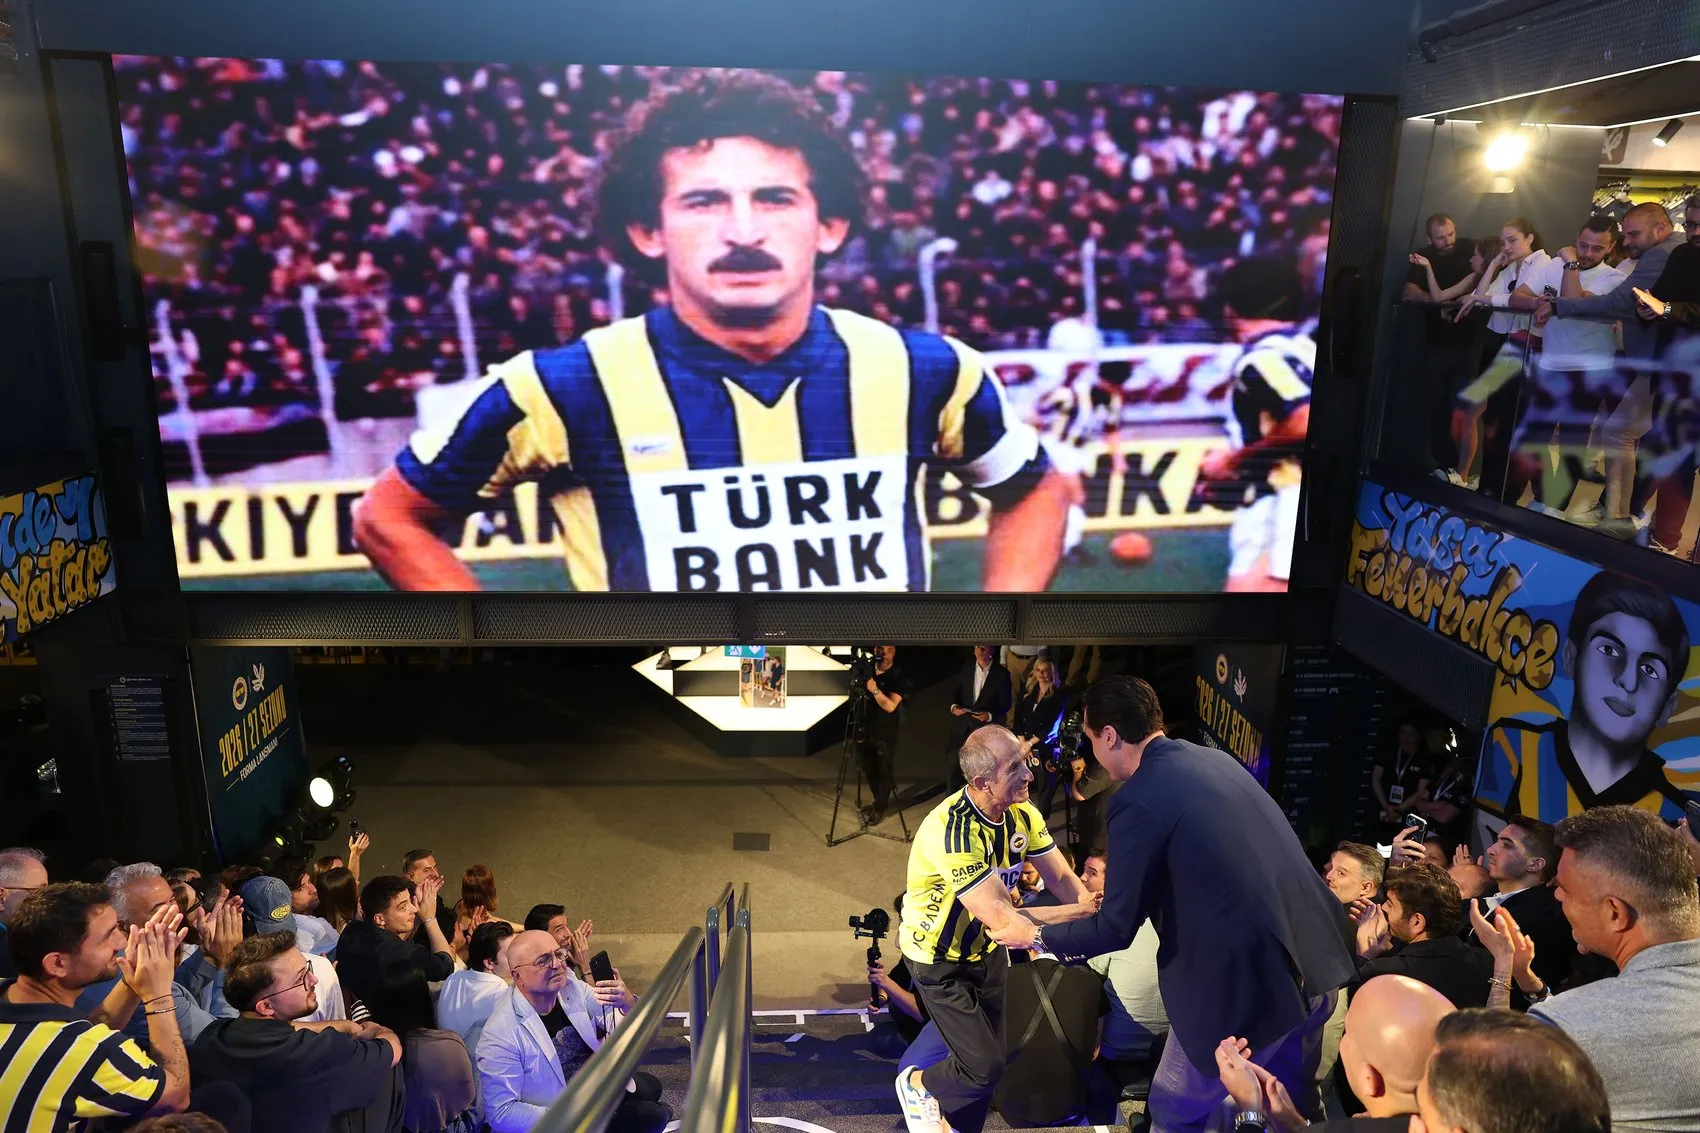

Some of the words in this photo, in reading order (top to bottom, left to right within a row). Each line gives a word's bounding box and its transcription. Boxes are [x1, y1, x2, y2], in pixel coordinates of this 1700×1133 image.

[661, 470, 883, 534] TÜRK
[0, 538, 110, 634] Yatar
[673, 532, 887, 592] BANK
[219, 724, 244, 778] 2026
[247, 708, 260, 751] 27
[258, 683, 287, 739] SEZONU
[1217, 698, 1232, 742] 27
[239, 758, 257, 782] FORMA
